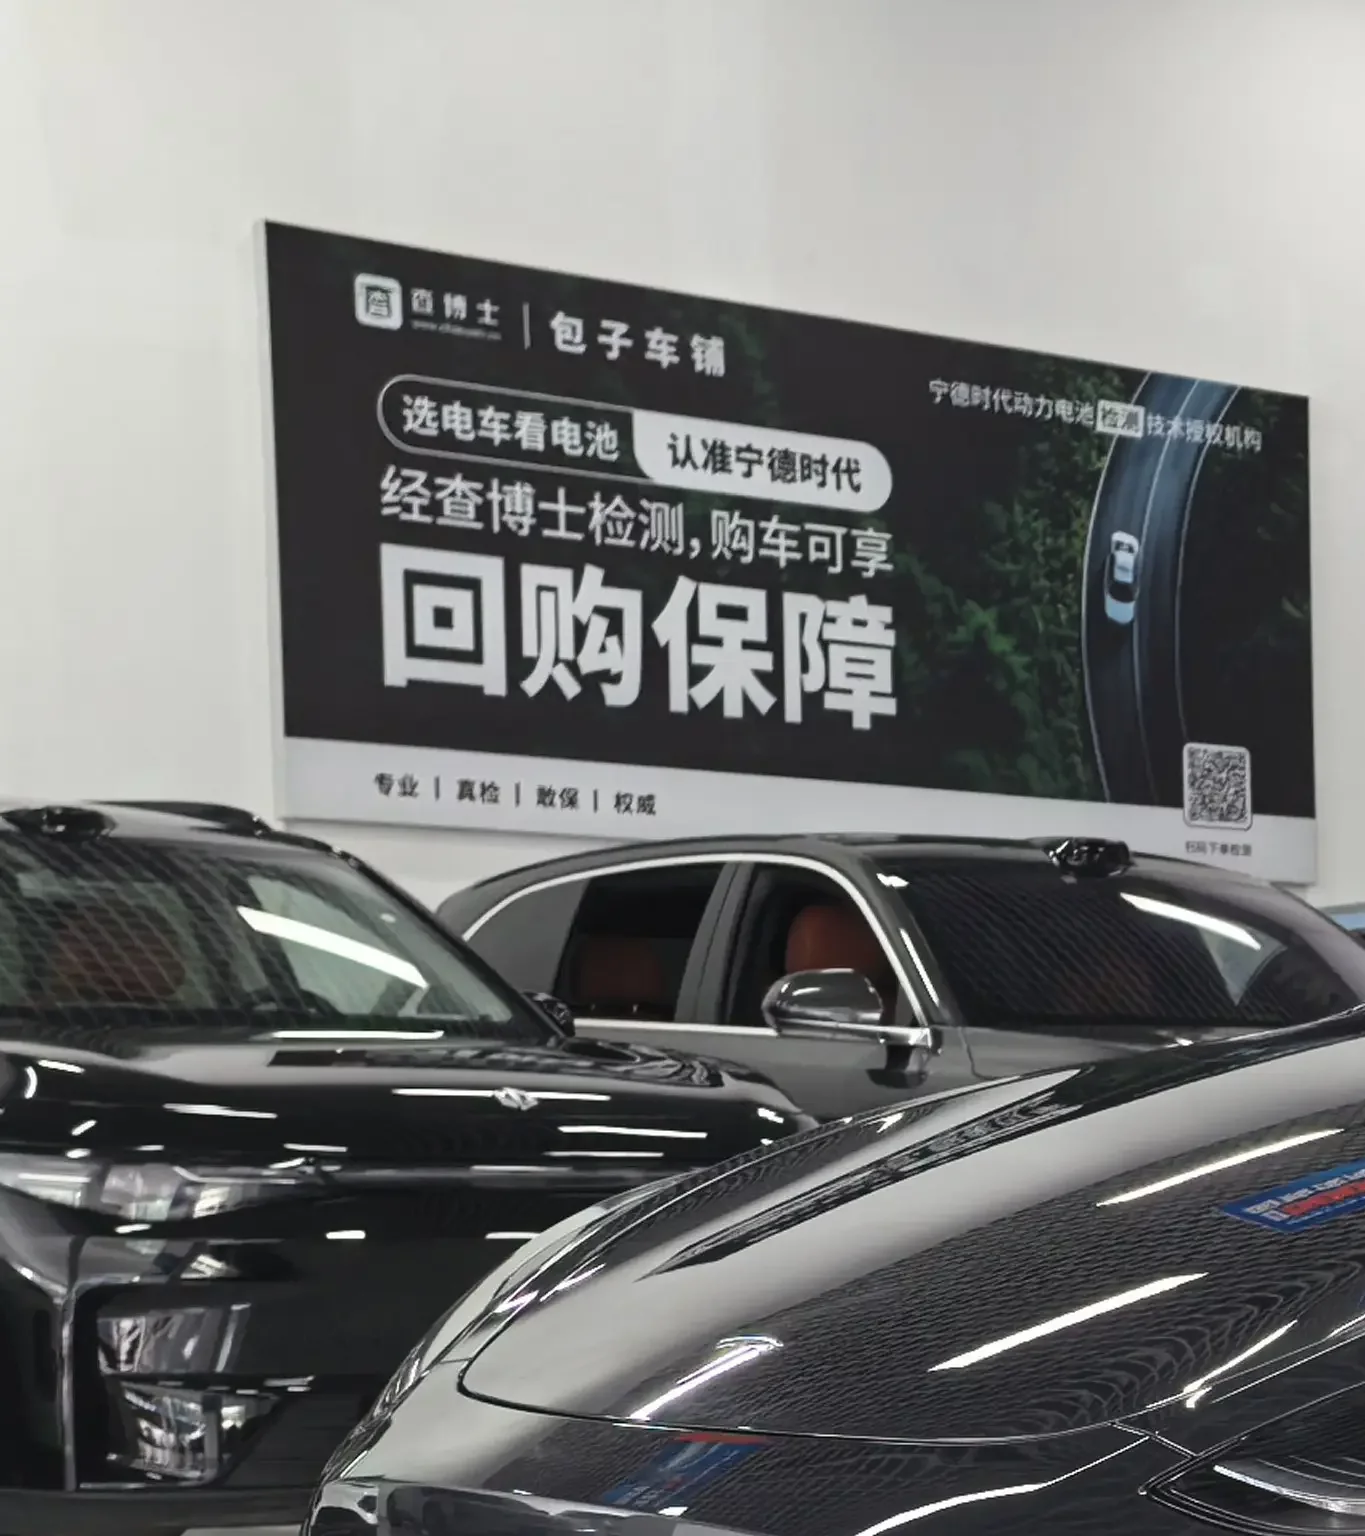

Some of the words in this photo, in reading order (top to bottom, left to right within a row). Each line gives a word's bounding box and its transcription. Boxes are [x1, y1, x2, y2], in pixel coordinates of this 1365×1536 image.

[550, 311, 726, 377] 包子车铺
[402, 395, 621, 463] 选电车看电池
[667, 433, 863, 494] 认准宁德时代
[380, 544, 897, 730] 回购保障
